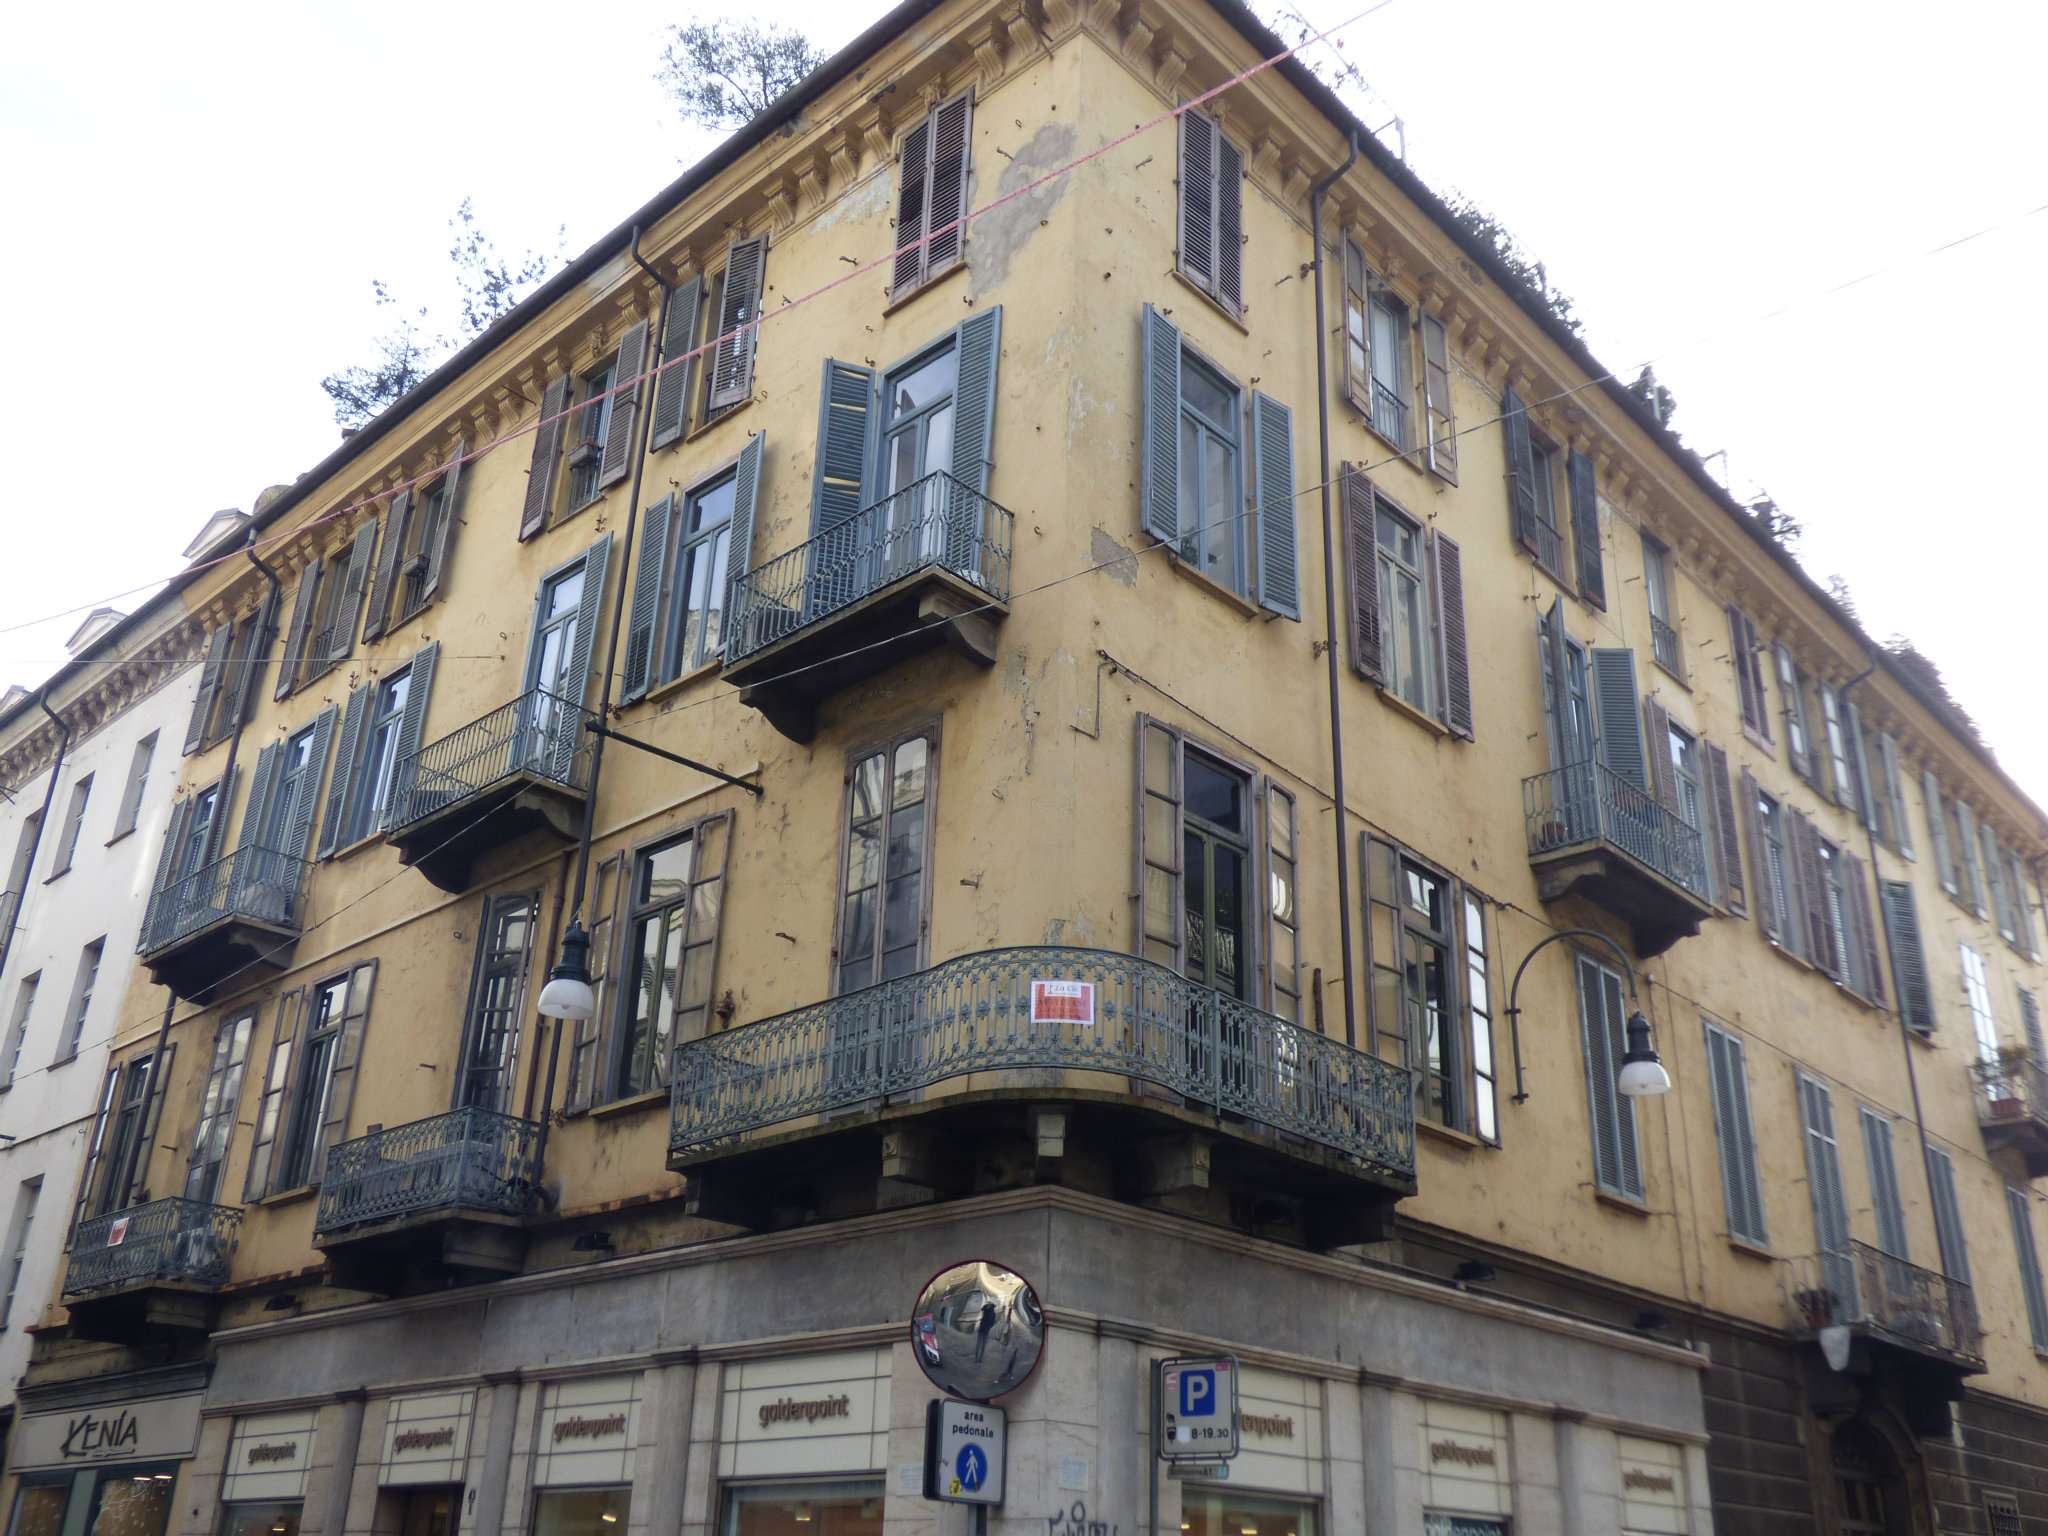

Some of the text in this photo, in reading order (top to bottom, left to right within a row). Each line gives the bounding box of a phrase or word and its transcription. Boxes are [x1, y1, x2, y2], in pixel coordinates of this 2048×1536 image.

[1187, 1375, 1208, 1411] P
[759, 1394, 850, 1429] goldenpoint
[964, 1410, 984, 1422] area
[554, 1414, 626, 1443] goldenpoint
[952, 1423, 994, 1438] pedonale
